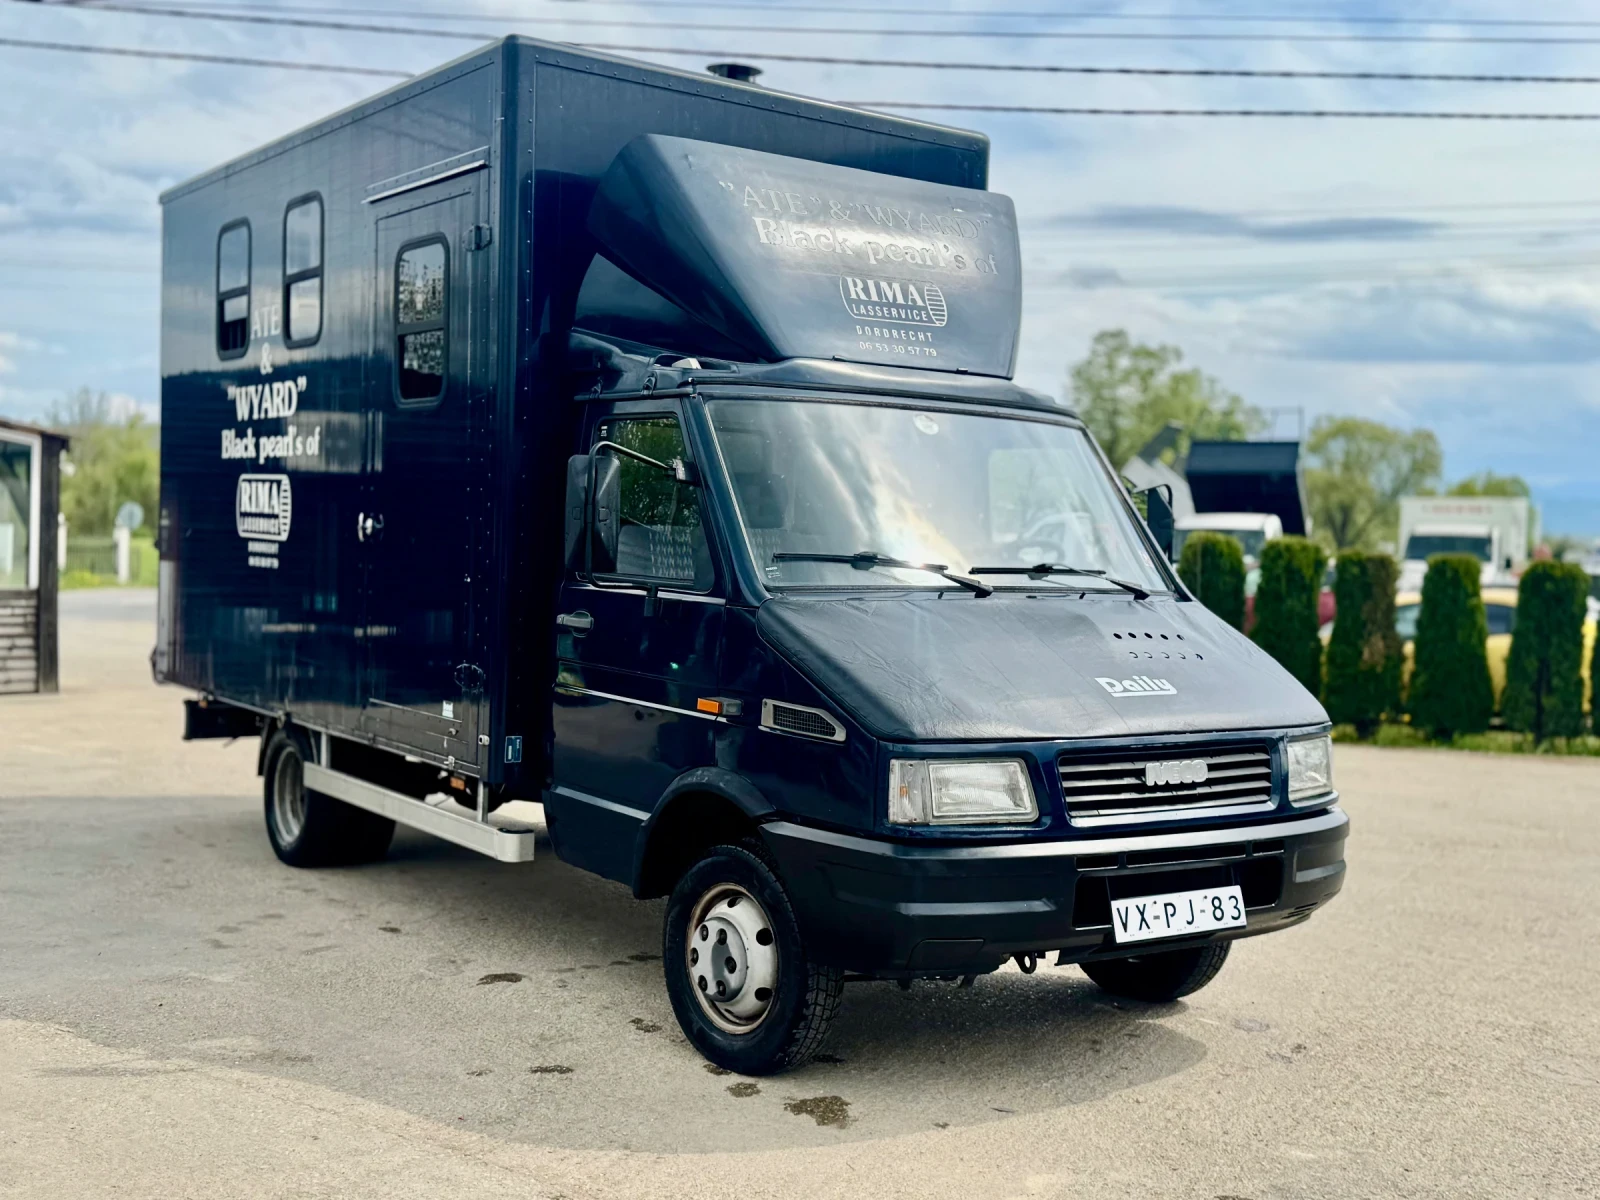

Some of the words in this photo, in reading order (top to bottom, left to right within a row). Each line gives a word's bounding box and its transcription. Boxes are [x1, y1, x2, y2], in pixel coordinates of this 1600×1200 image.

[828, 199, 852, 222] &
[752, 216, 854, 255] Black
[862, 239, 967, 271] pearl's
[974, 253, 999, 276] of
[844, 276, 926, 307] RIMA
[852, 303, 928, 321] LASSERVICE
[856, 325, 933, 342] DORDRECHT
[260, 341, 274, 375] &
[859, 341, 873, 350] 06
[875, 343, 889, 352] 53
[891, 344, 905, 354] 30
[907, 346, 920, 355] 57
[923, 348, 937, 357] 79
[221, 427, 257, 460] Black
[258, 424, 303, 465] pearl's
[305, 426, 321, 456] of
[240, 480, 280, 515] RIMA
[1094, 675, 1178, 698] Daily
